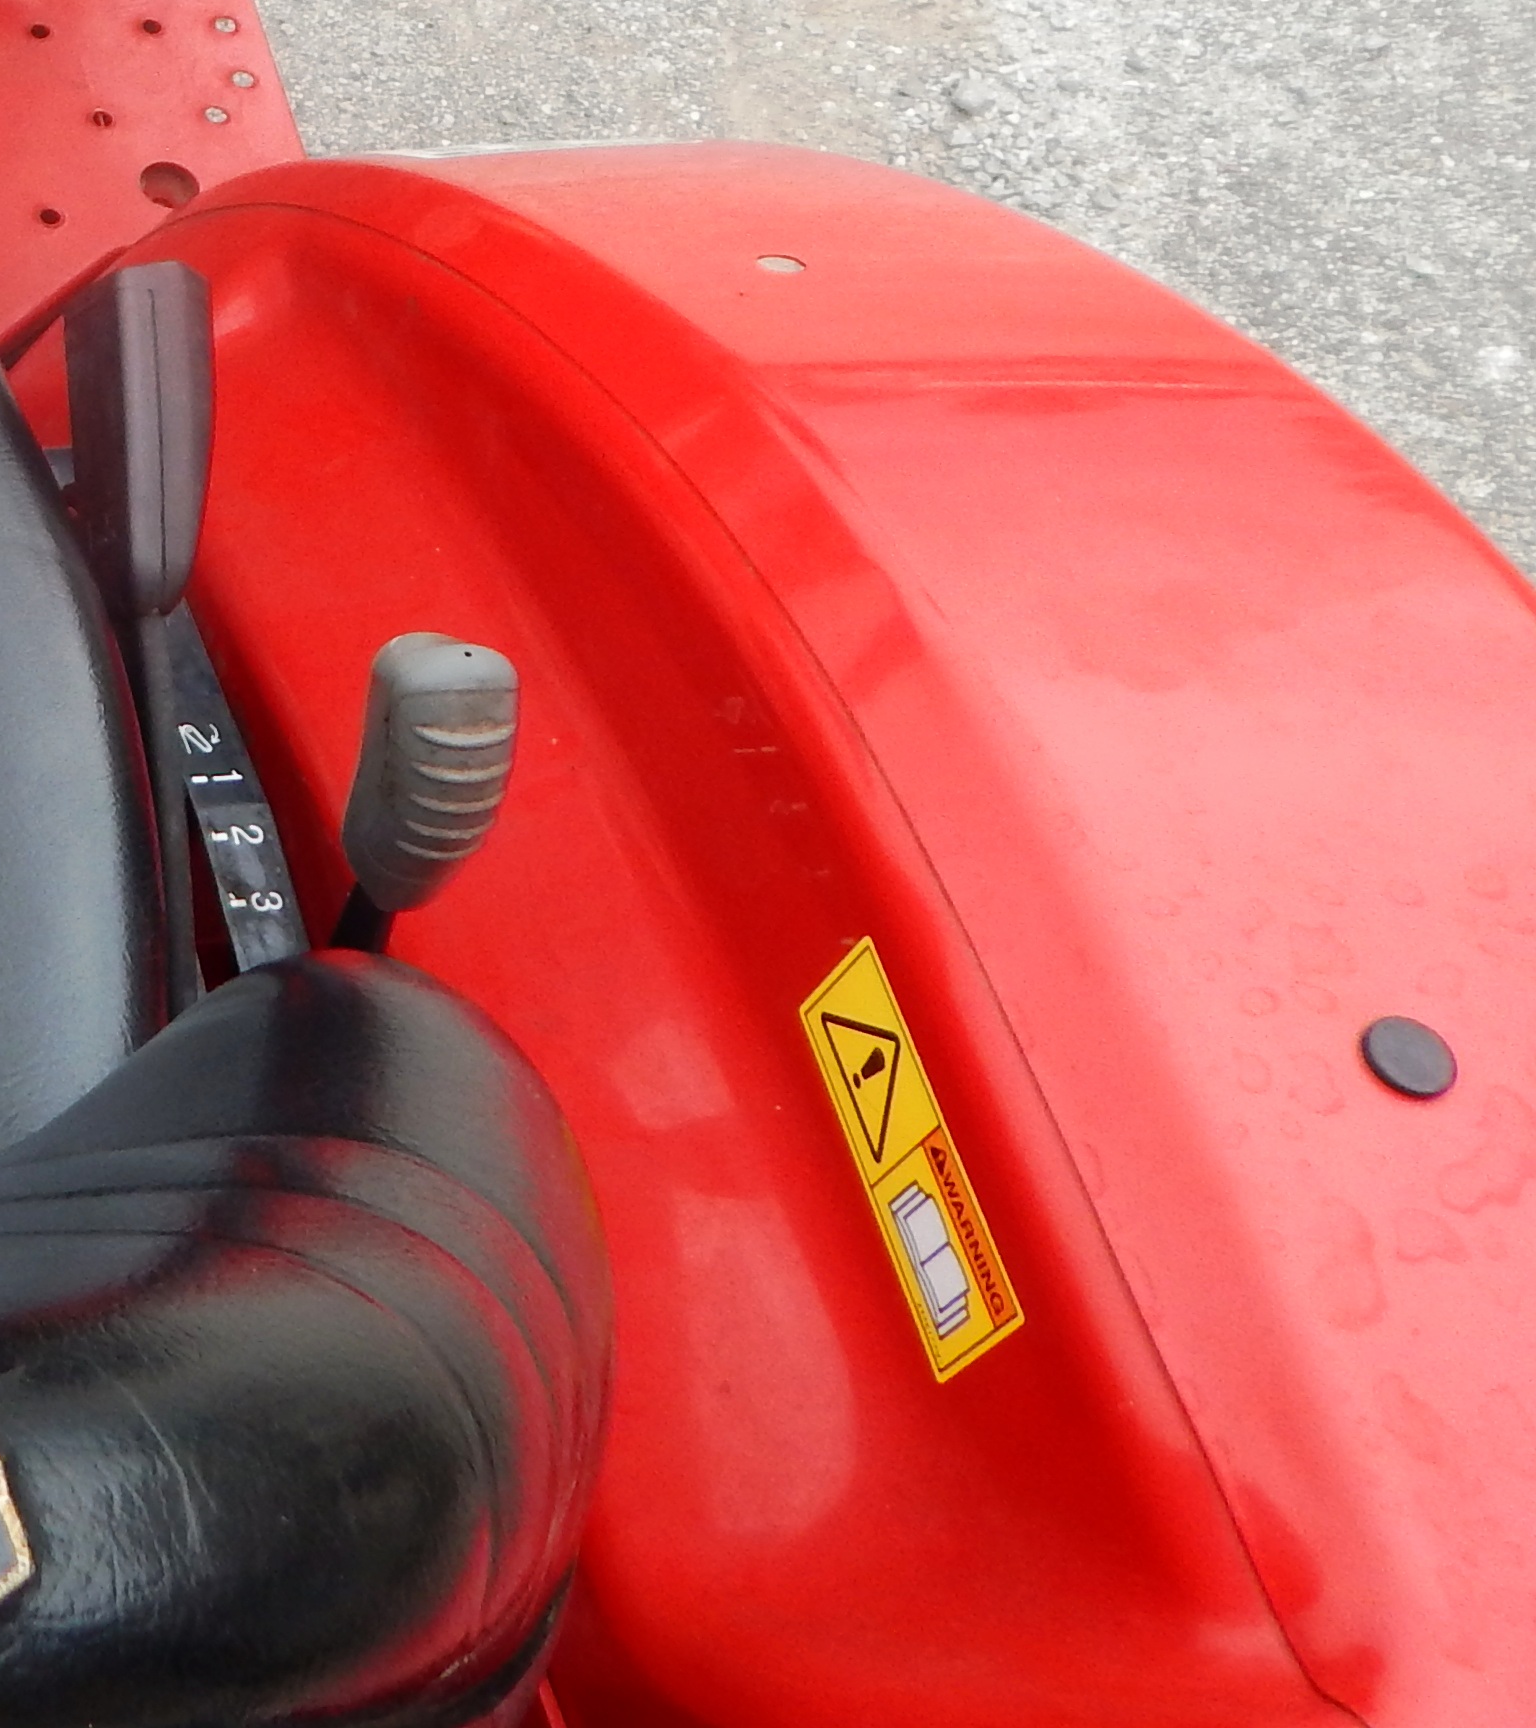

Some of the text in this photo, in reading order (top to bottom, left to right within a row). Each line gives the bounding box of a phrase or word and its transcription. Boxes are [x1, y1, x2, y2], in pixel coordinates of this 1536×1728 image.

[212, 769, 243, 782] 1
[230, 824, 264, 845] 2
[250, 891, 283, 912] 3
[943, 1172, 1005, 1316] WARNING
